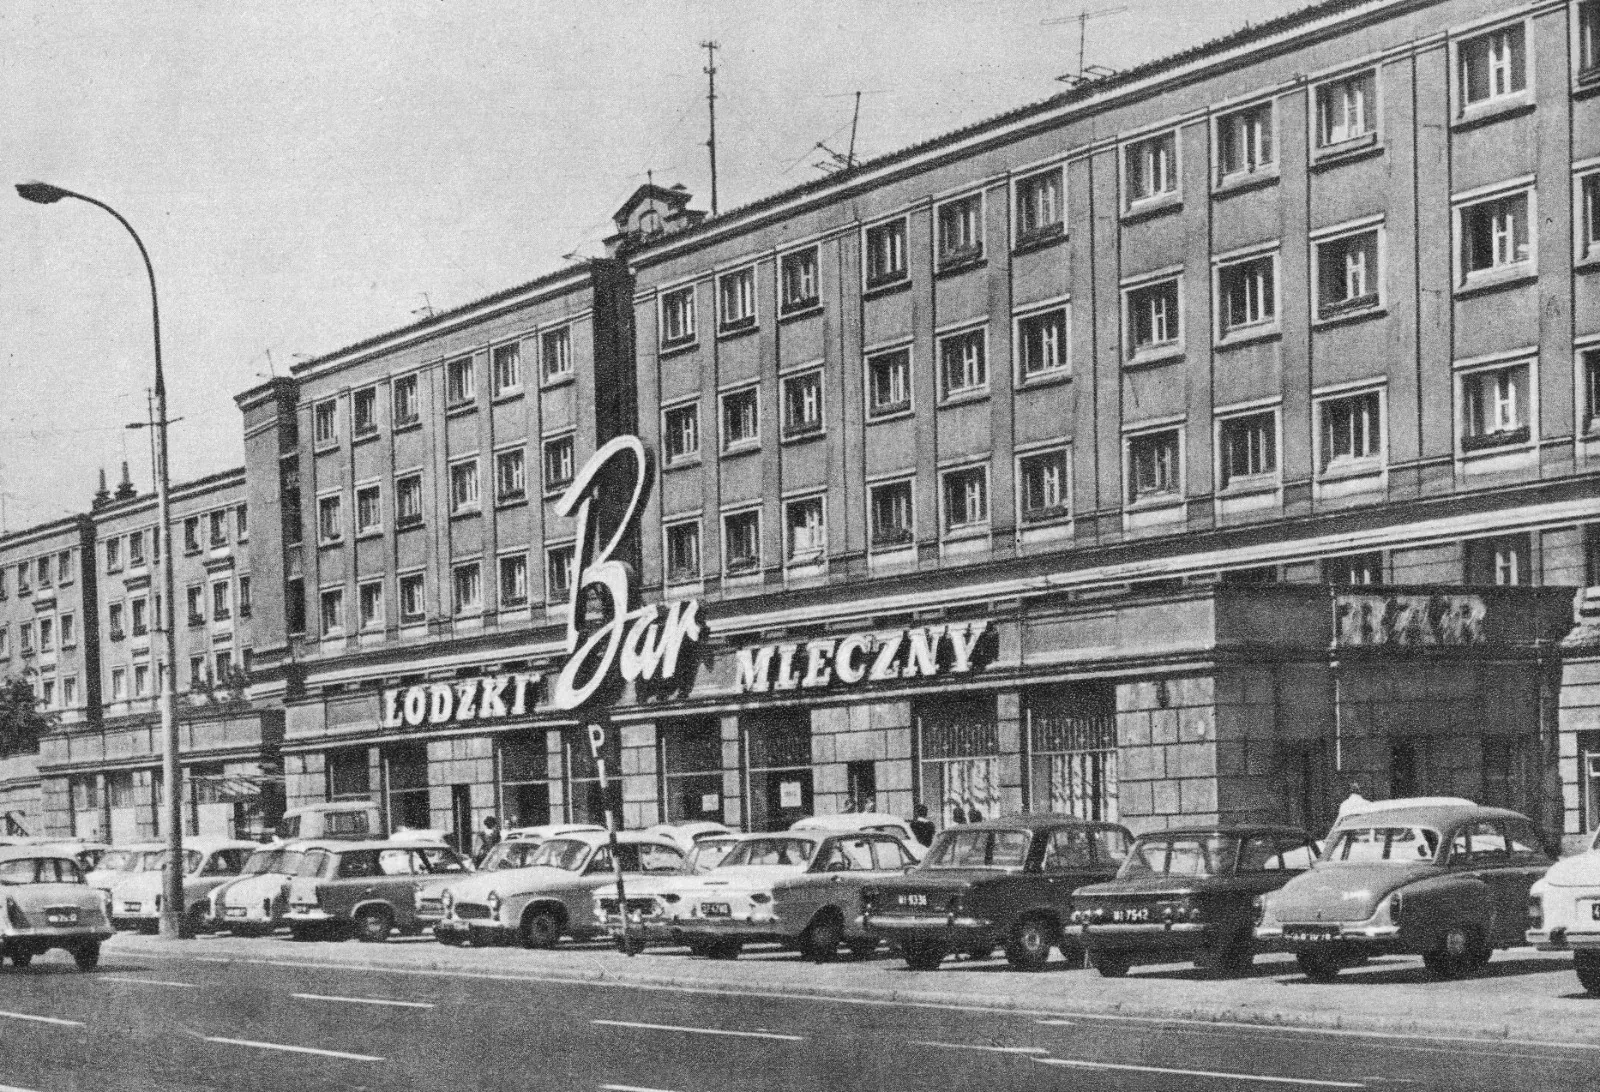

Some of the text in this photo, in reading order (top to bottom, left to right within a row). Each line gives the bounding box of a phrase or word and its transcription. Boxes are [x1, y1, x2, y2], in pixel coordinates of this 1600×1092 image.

[554, 434, 700, 710] Bar
[730, 619, 988, 694] MLECZNY
[588, 724, 605, 758] P
